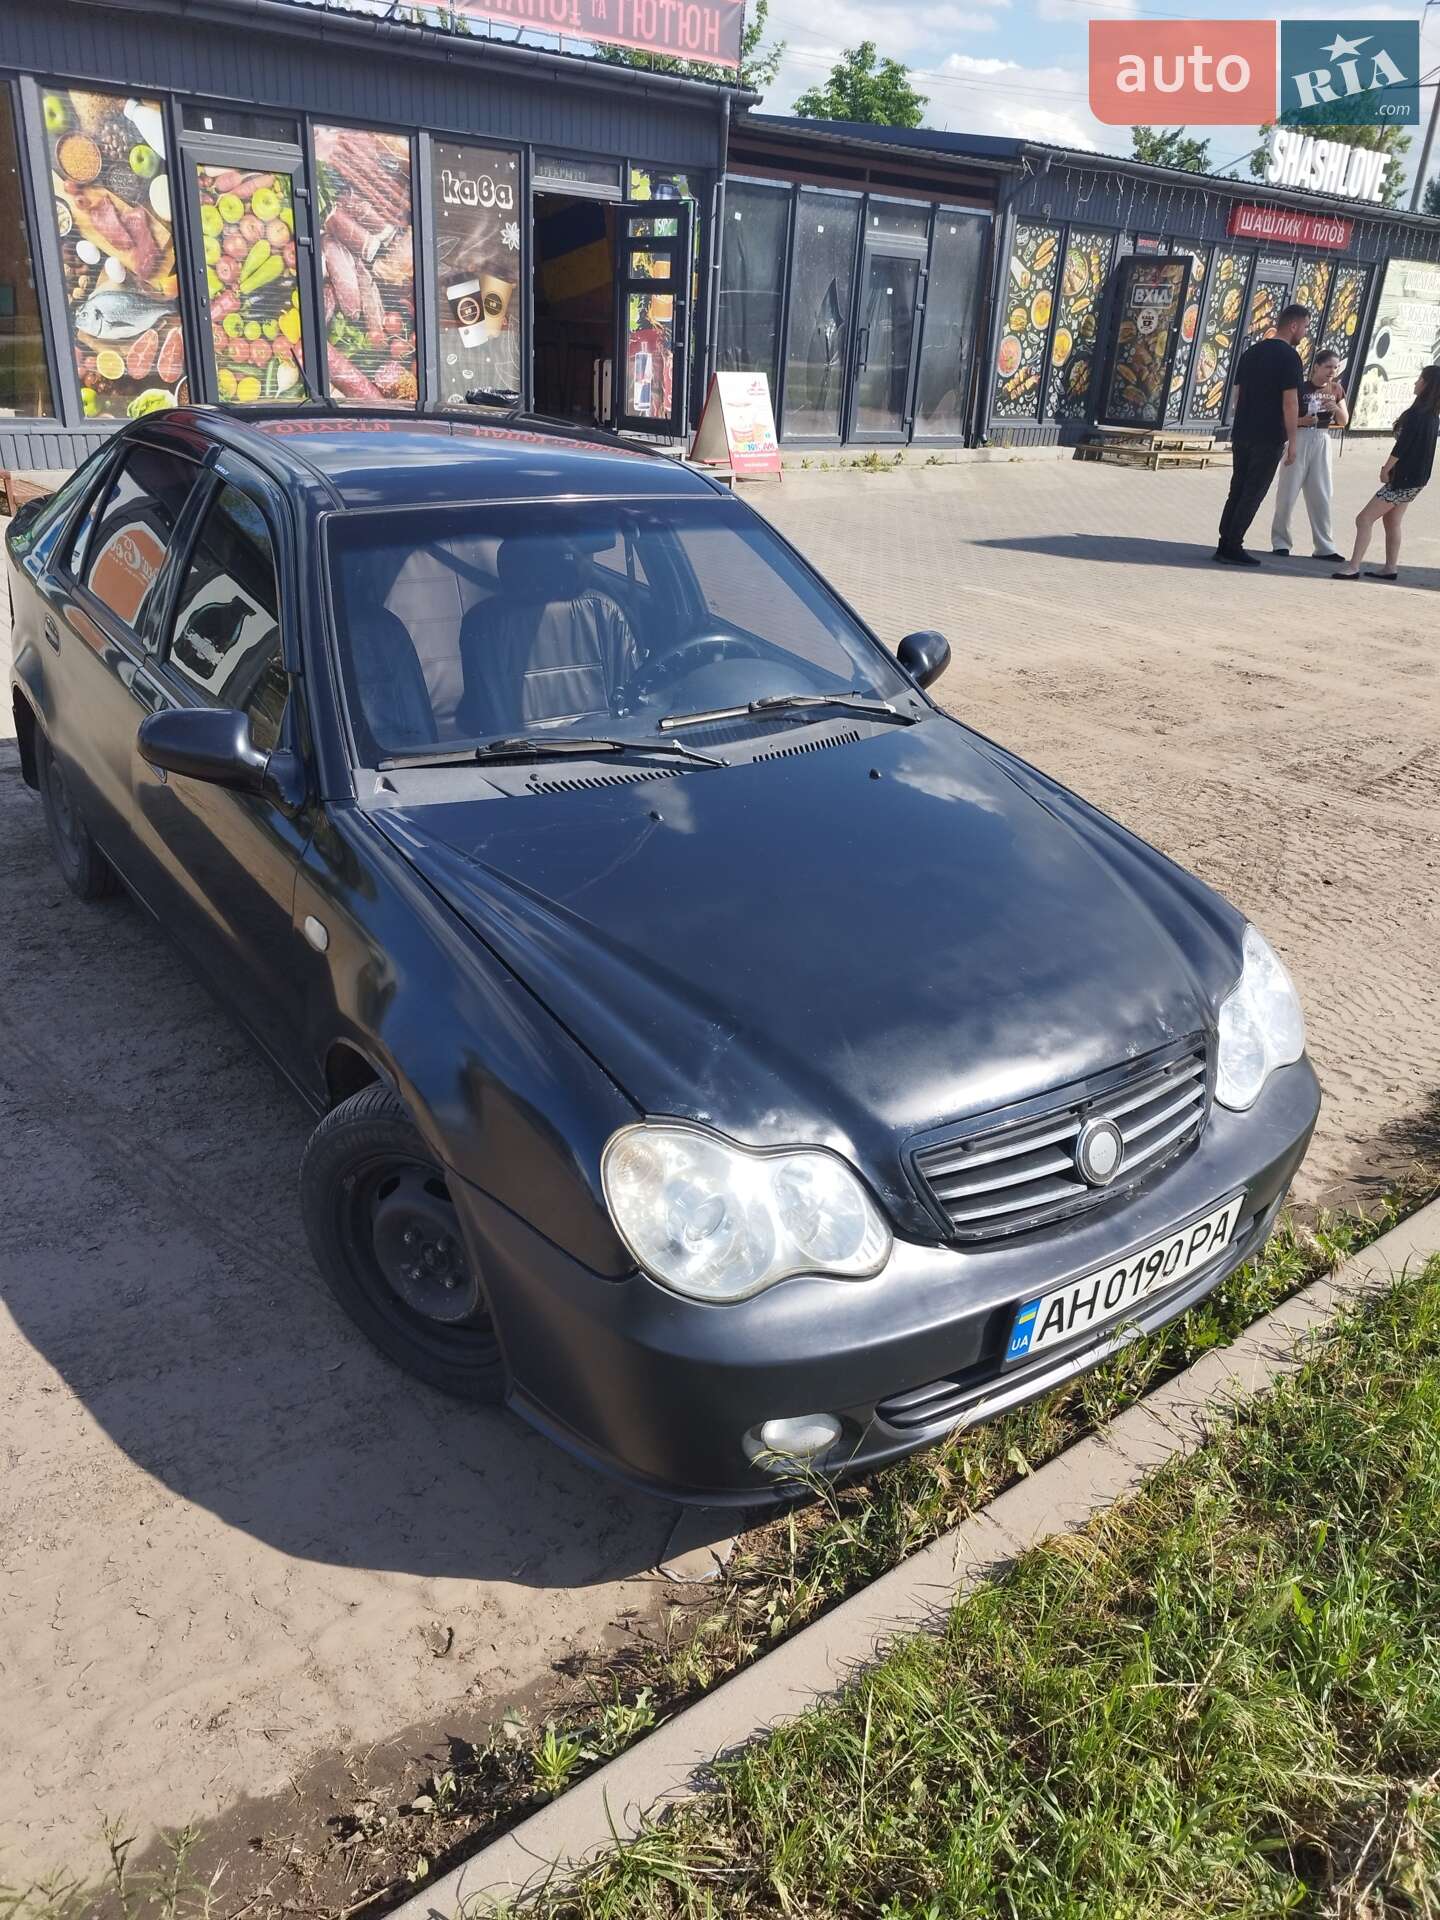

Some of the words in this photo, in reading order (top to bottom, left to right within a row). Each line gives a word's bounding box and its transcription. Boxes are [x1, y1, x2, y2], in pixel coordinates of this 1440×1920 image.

[1265, 129, 1391, 202] SHASHLOVE
[441, 169, 513, 210] кава
[1240, 211, 1301, 238] ШАШЛИК
[1311, 222, 1345, 244] ПЛОВ
[1134, 288, 1171, 304] ВХІД
[1011, 1336, 1029, 1351] UA
